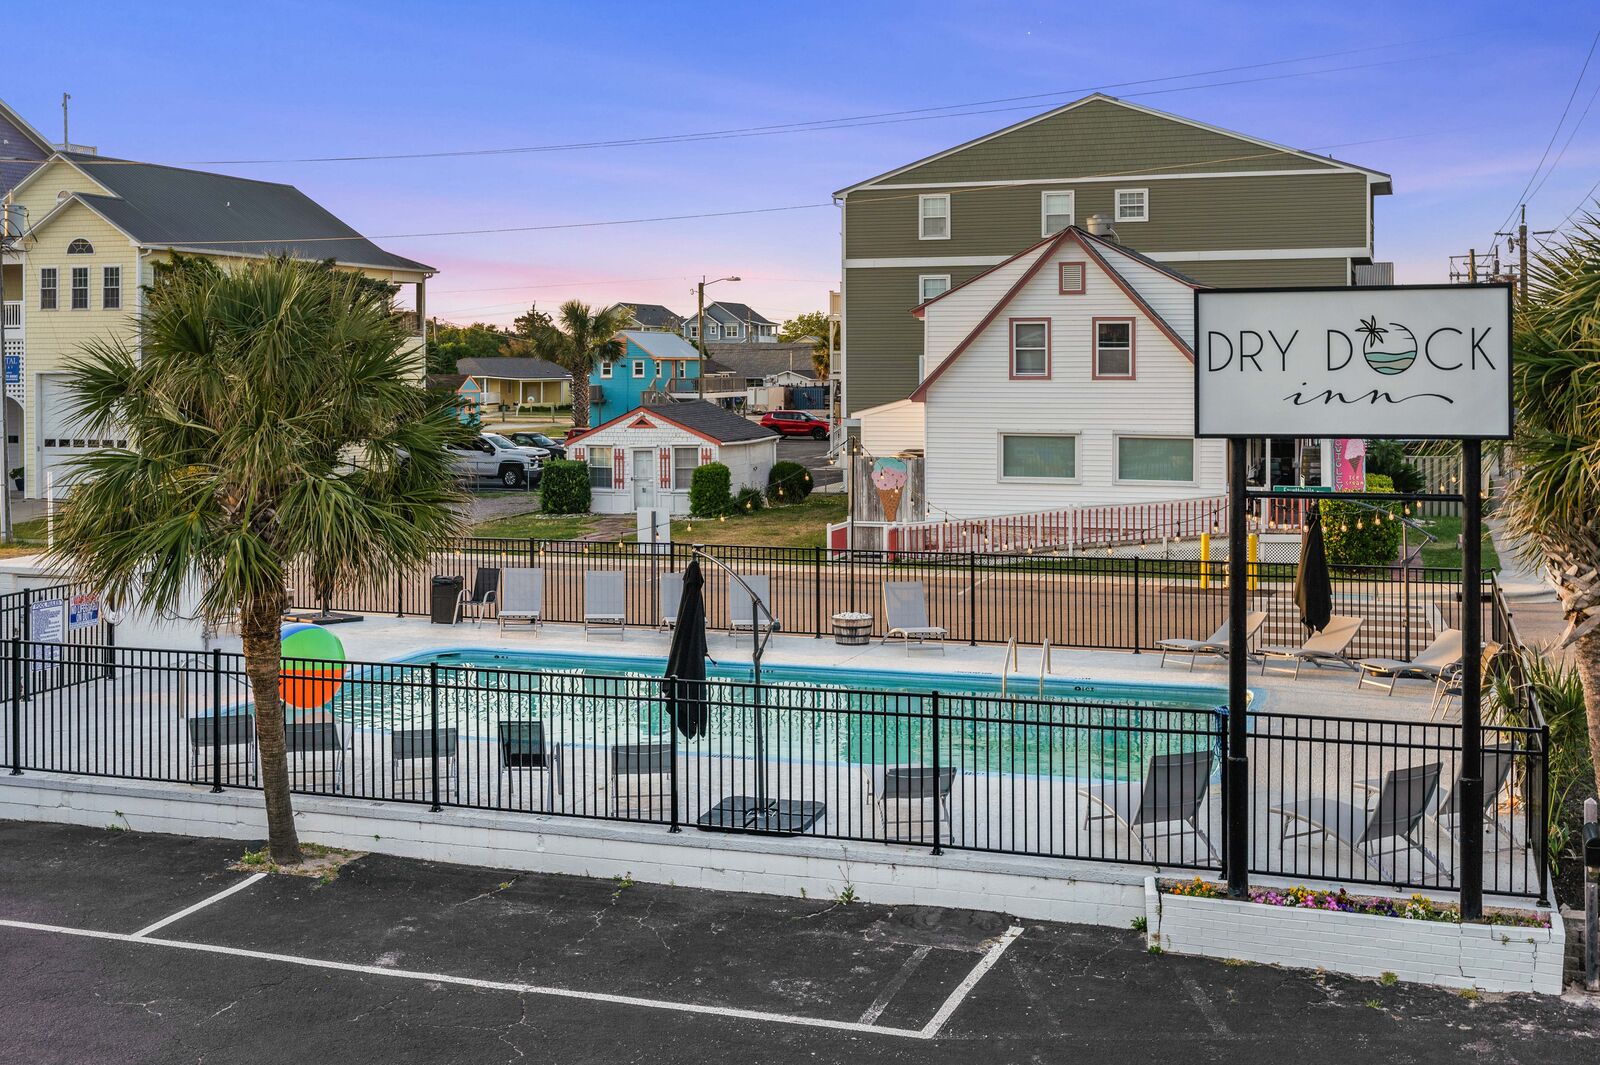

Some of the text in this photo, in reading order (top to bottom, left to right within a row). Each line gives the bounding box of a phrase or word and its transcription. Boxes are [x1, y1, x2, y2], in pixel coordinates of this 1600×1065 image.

[1208, 320, 1497, 376] DRY DOCK
[1283, 382, 1454, 406] inn
